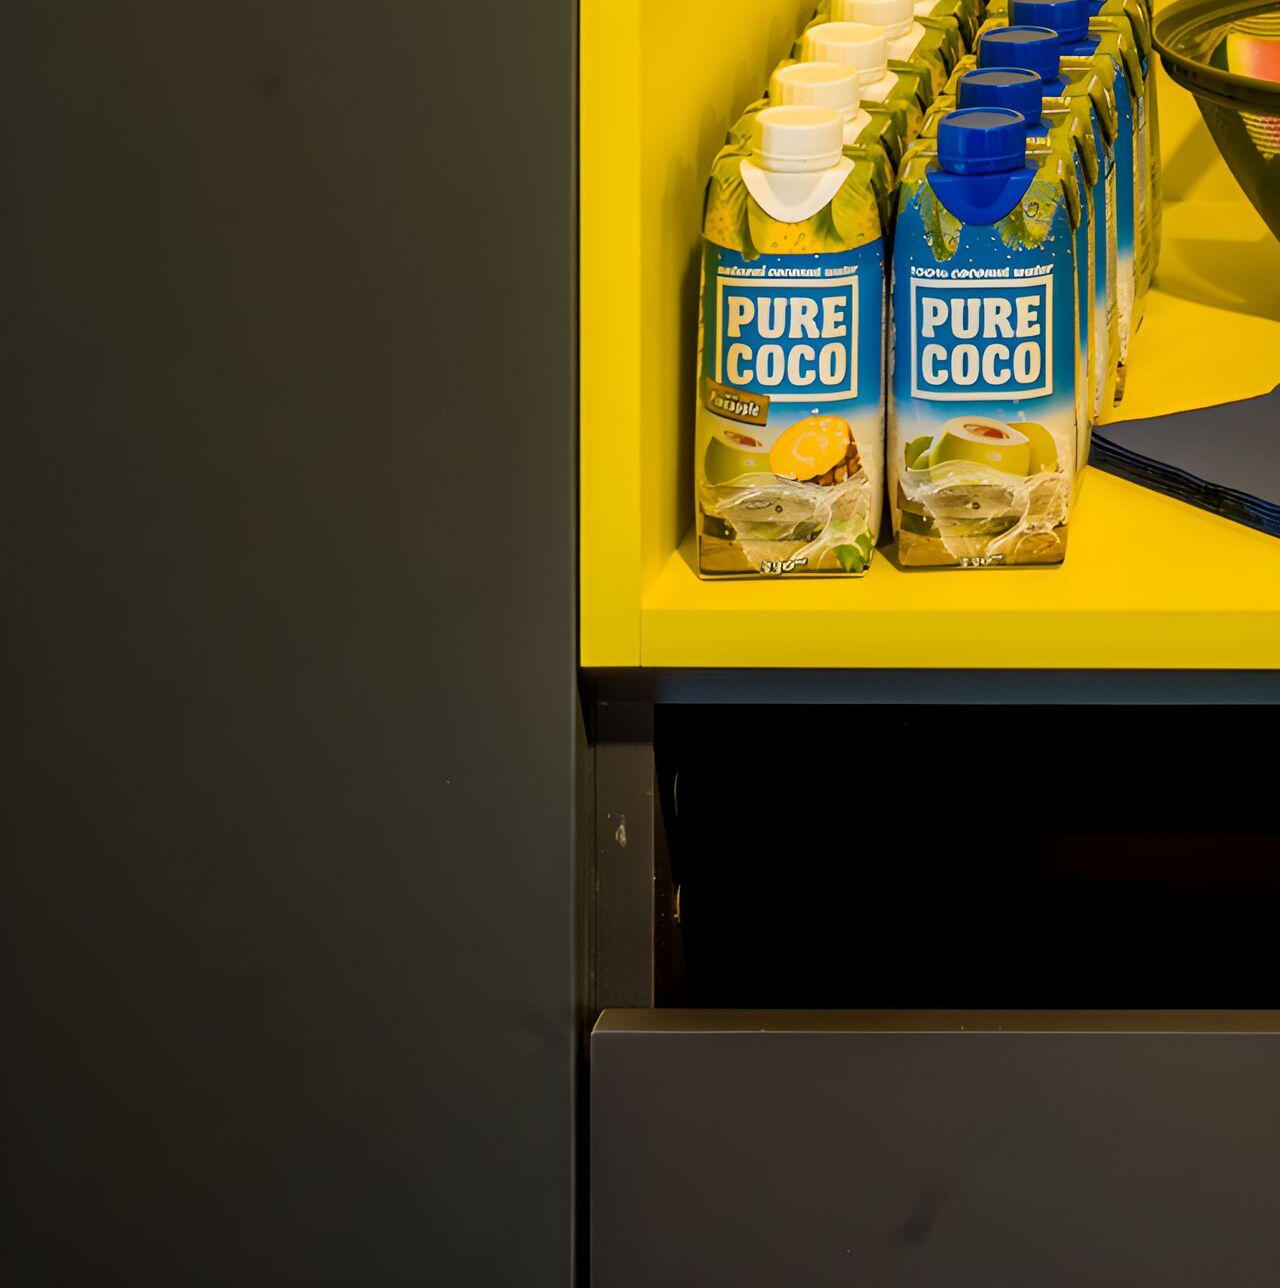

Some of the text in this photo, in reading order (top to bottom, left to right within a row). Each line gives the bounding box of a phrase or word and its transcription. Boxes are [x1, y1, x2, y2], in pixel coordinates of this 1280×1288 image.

[727, 296, 847, 339] PURE
[921, 295, 1041, 339] PURE
[726, 342, 847, 386] COCO
[921, 341, 1042, 386] COCO
